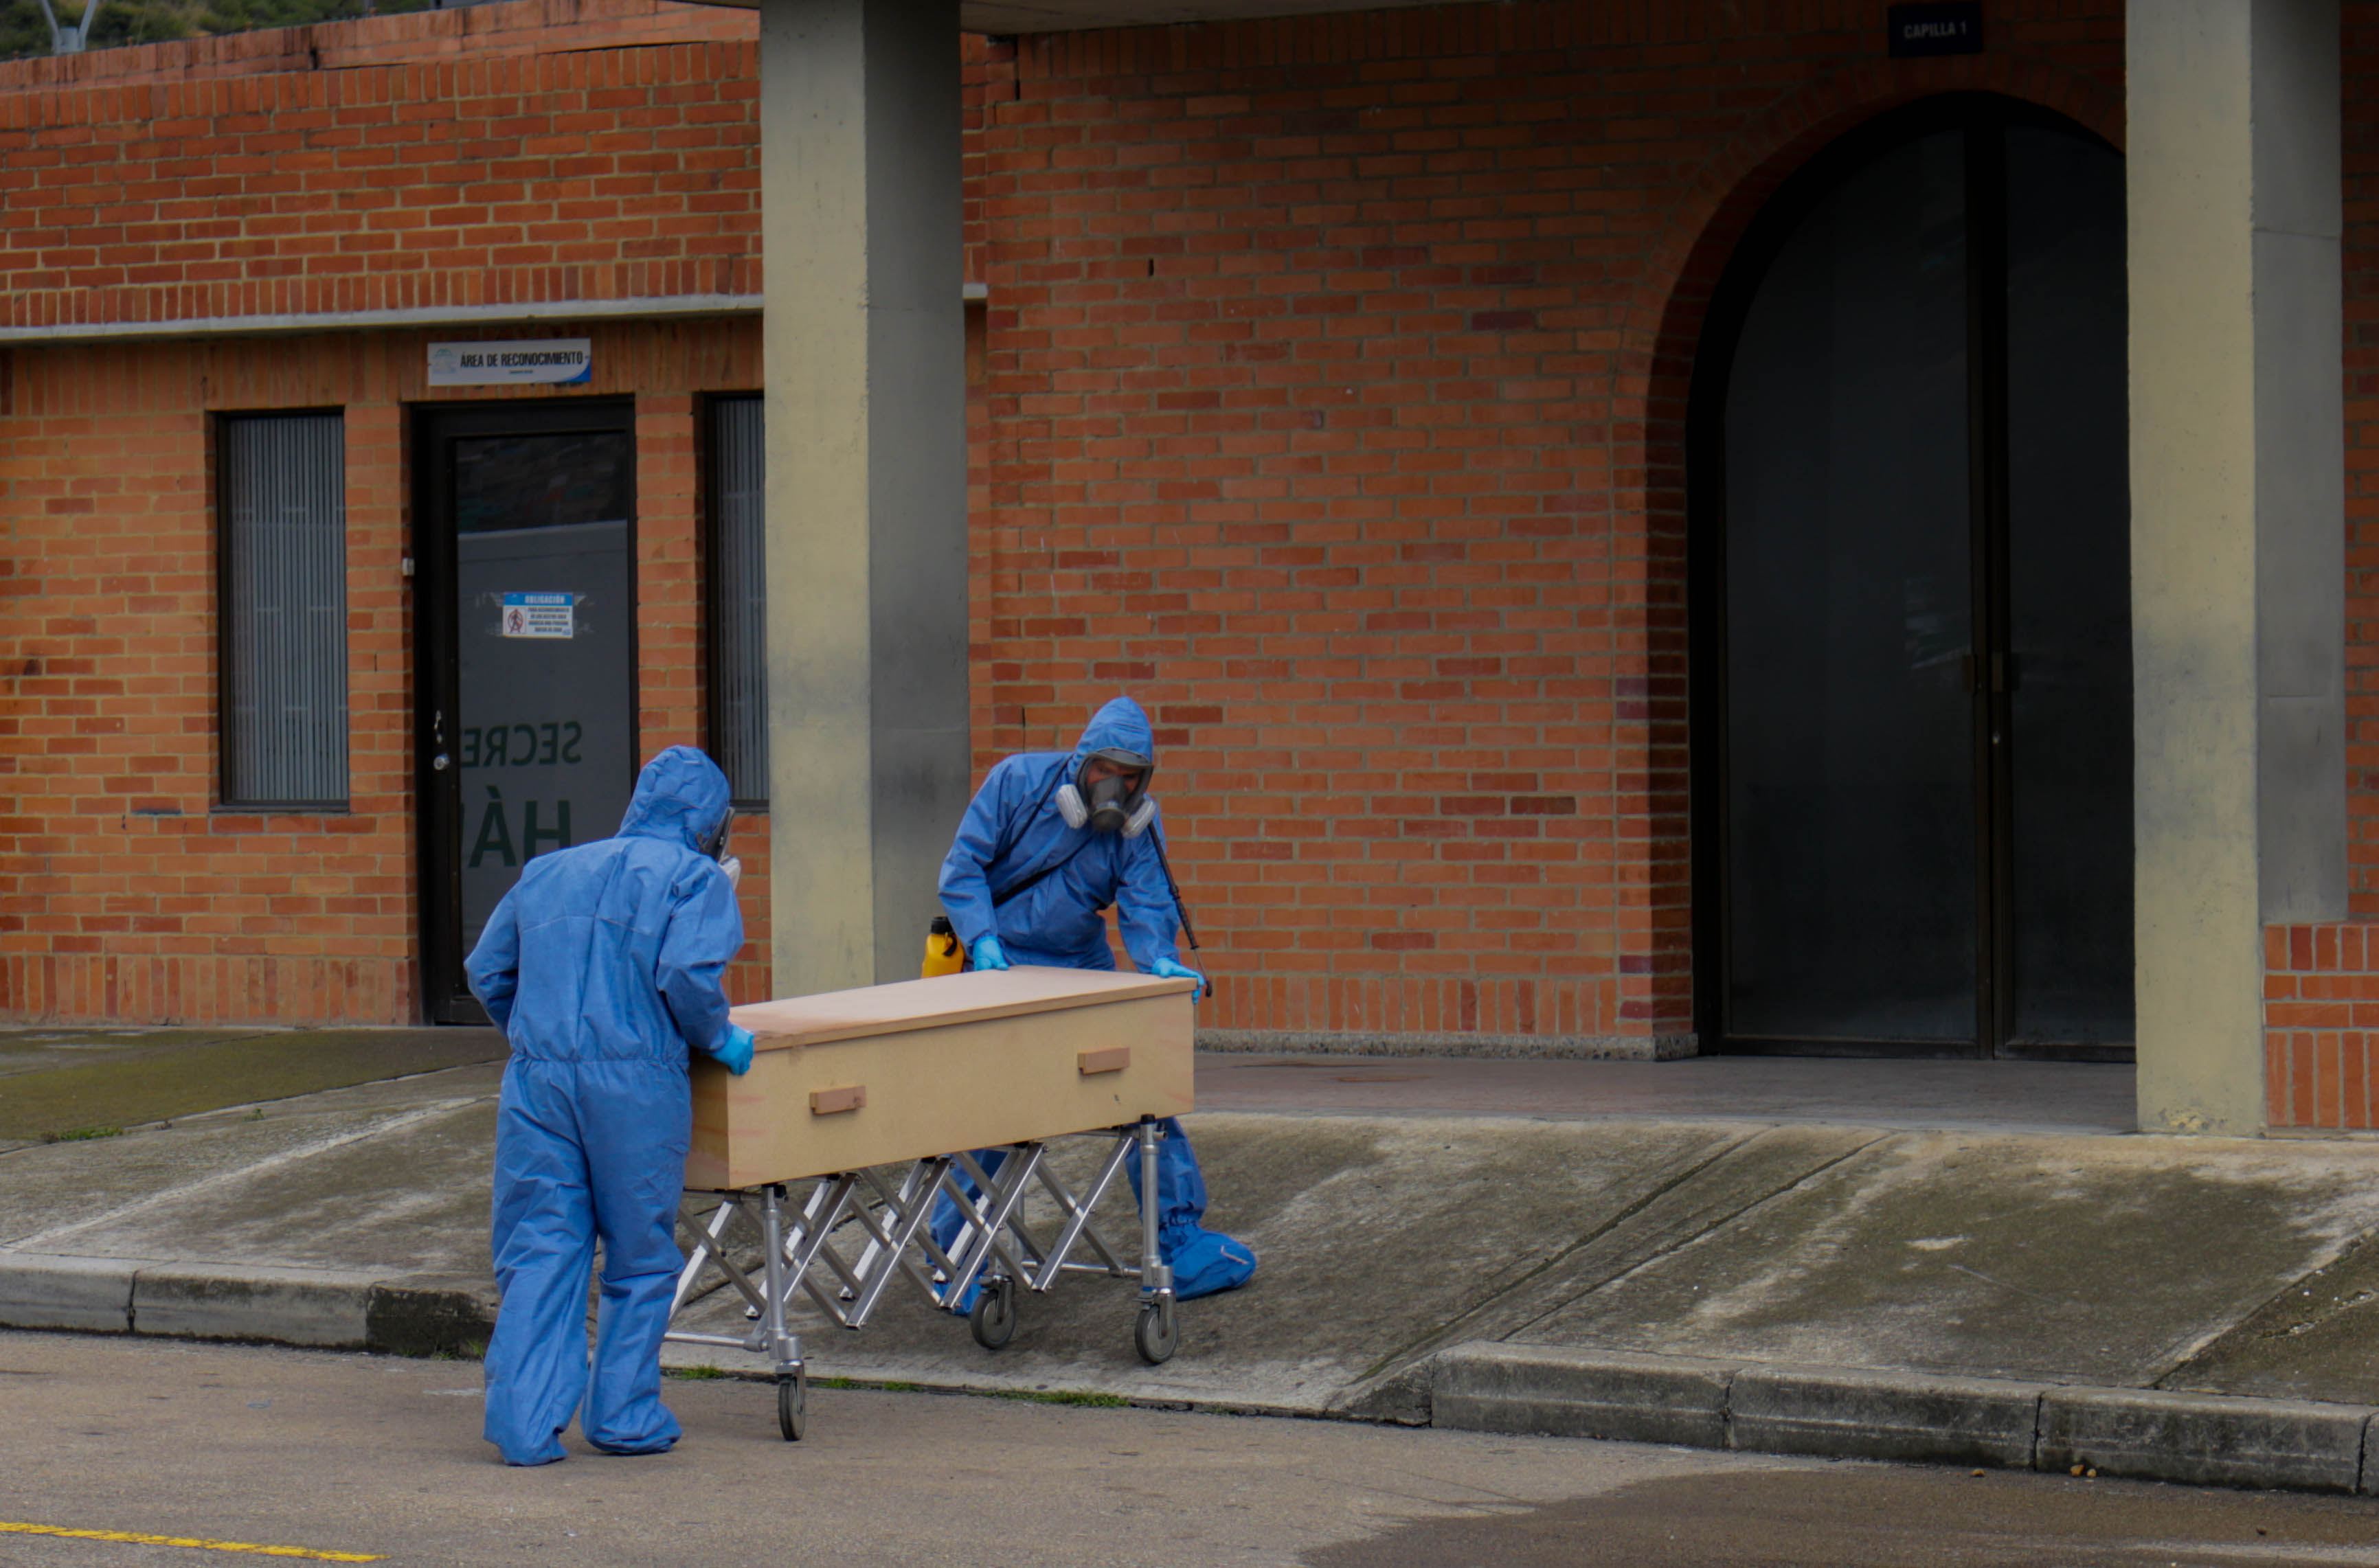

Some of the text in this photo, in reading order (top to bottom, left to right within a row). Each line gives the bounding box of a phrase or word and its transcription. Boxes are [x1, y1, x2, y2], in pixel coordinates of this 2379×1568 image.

[1903, 19, 1968, 39] CAPILLA 1
[460, 350, 583, 367] ÁREA DE RECONOCIMIENTO
